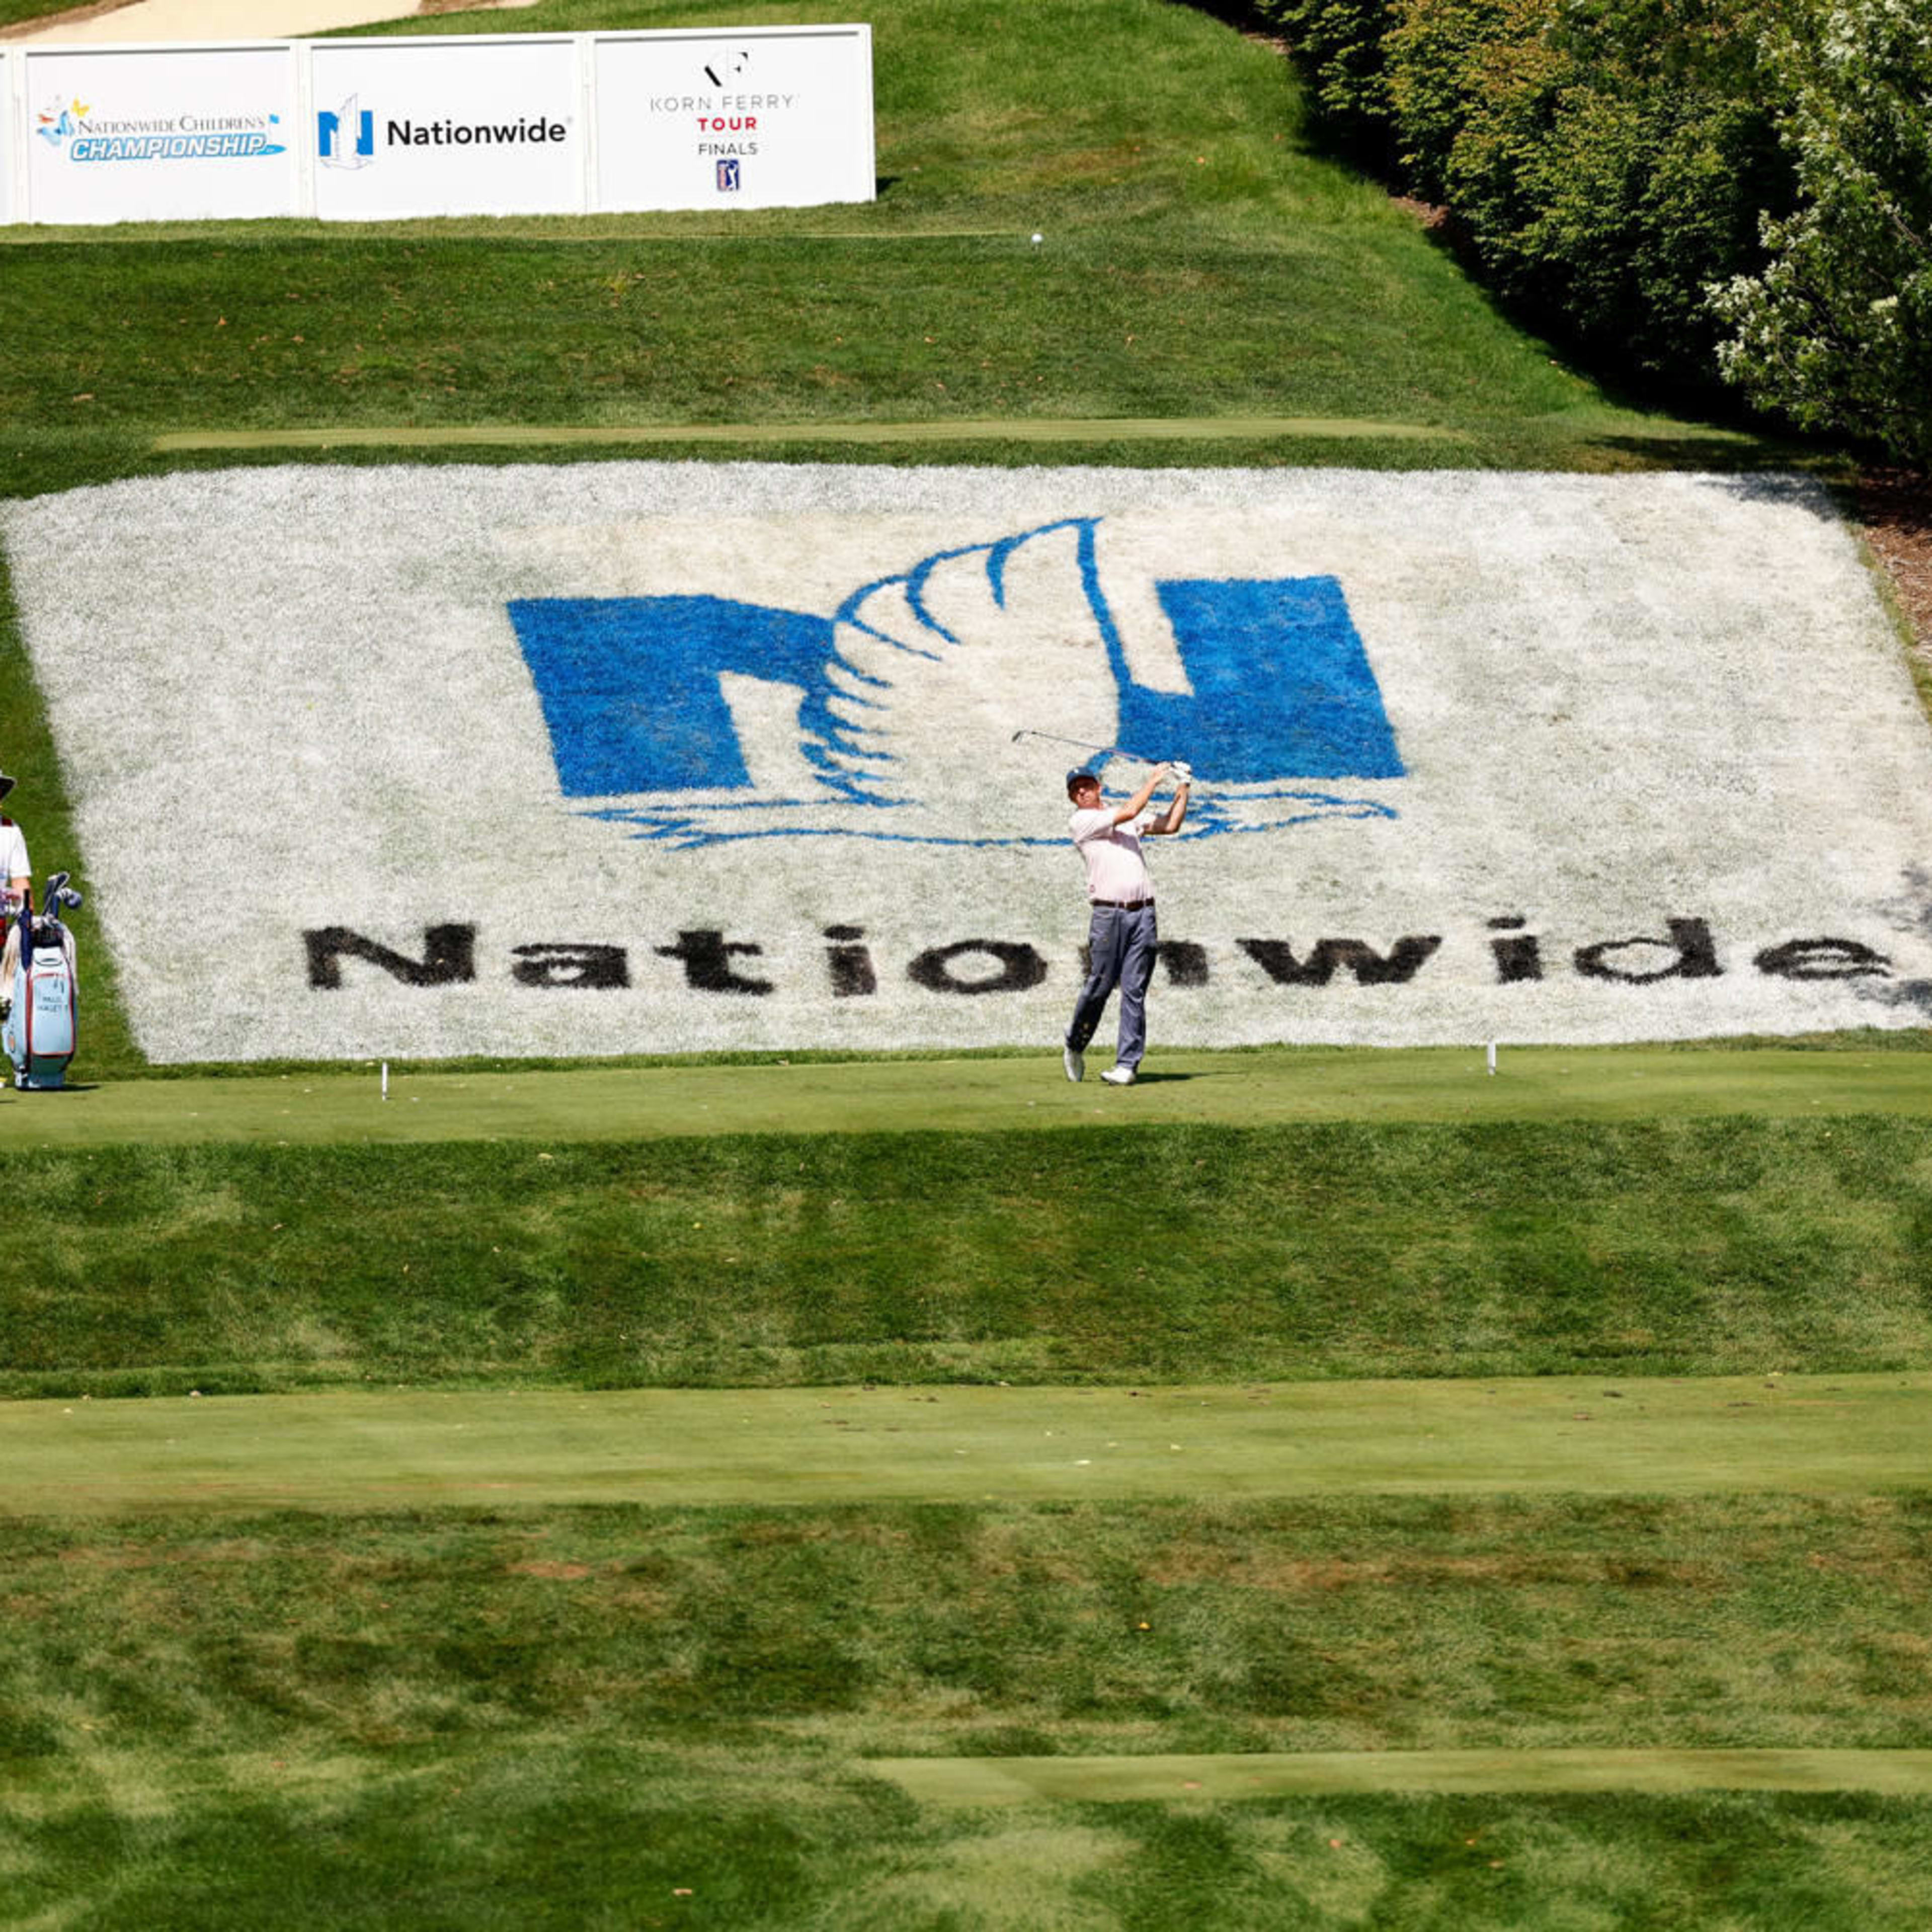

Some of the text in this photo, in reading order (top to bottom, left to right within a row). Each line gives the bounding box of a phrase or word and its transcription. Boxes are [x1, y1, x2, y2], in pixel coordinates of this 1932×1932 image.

[650, 94, 793, 112] KORN FERRY
[78, 119, 175, 134] NATIONWIDE
[387, 117, 567, 146] Nationwide
[697, 117, 757, 132] TOUR
[71, 133, 267, 161] CHAMPIONSHIP
[698, 142, 758, 155] FINALS
